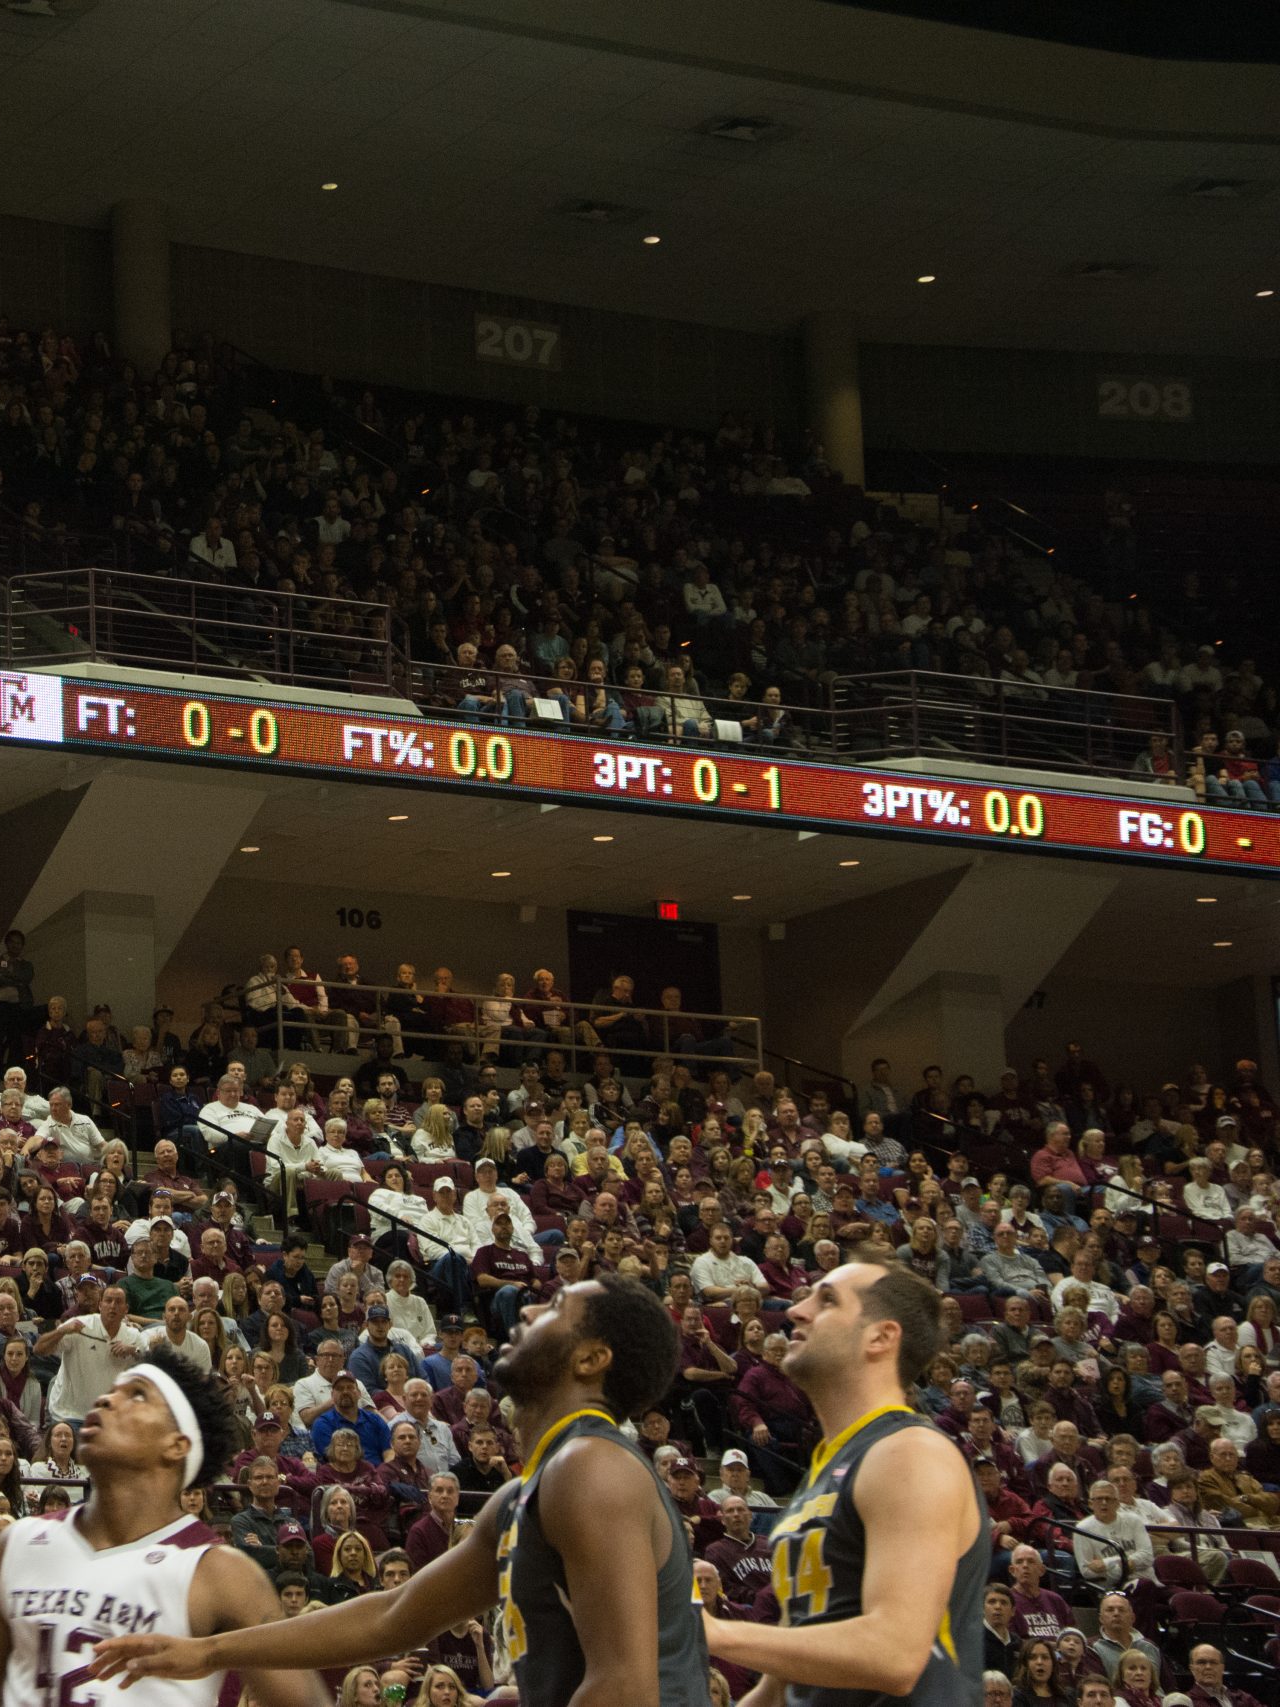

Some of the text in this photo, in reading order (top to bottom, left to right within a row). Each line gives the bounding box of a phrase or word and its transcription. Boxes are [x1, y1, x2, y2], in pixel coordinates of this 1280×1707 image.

[476, 319, 560, 366] 207
[1099, 381, 1192, 418] 208
[77, 695, 136, 736] FT:
[183, 700, 210, 749] 0
[250, 708, 279, 755] 0
[342, 724, 435, 769] FT%:
[450, 731, 514, 780] 0.0
[593, 752, 672, 795] 3PT:
[692, 757, 719, 802] 0
[863, 782, 971, 826] 3PT%:
[984, 790, 1044, 837] 0.0
[1118, 809, 1174, 848] FG:
[1179, 811, 1206, 854] 0
[336, 906, 382, 930] 106
[732, 1556, 760, 1581] TEXAS
[772, 1527, 834, 1622] 44
[9, 1588, 162, 1634] TEXAS A&M
[1023, 1612, 1060, 1626] TEXAS
